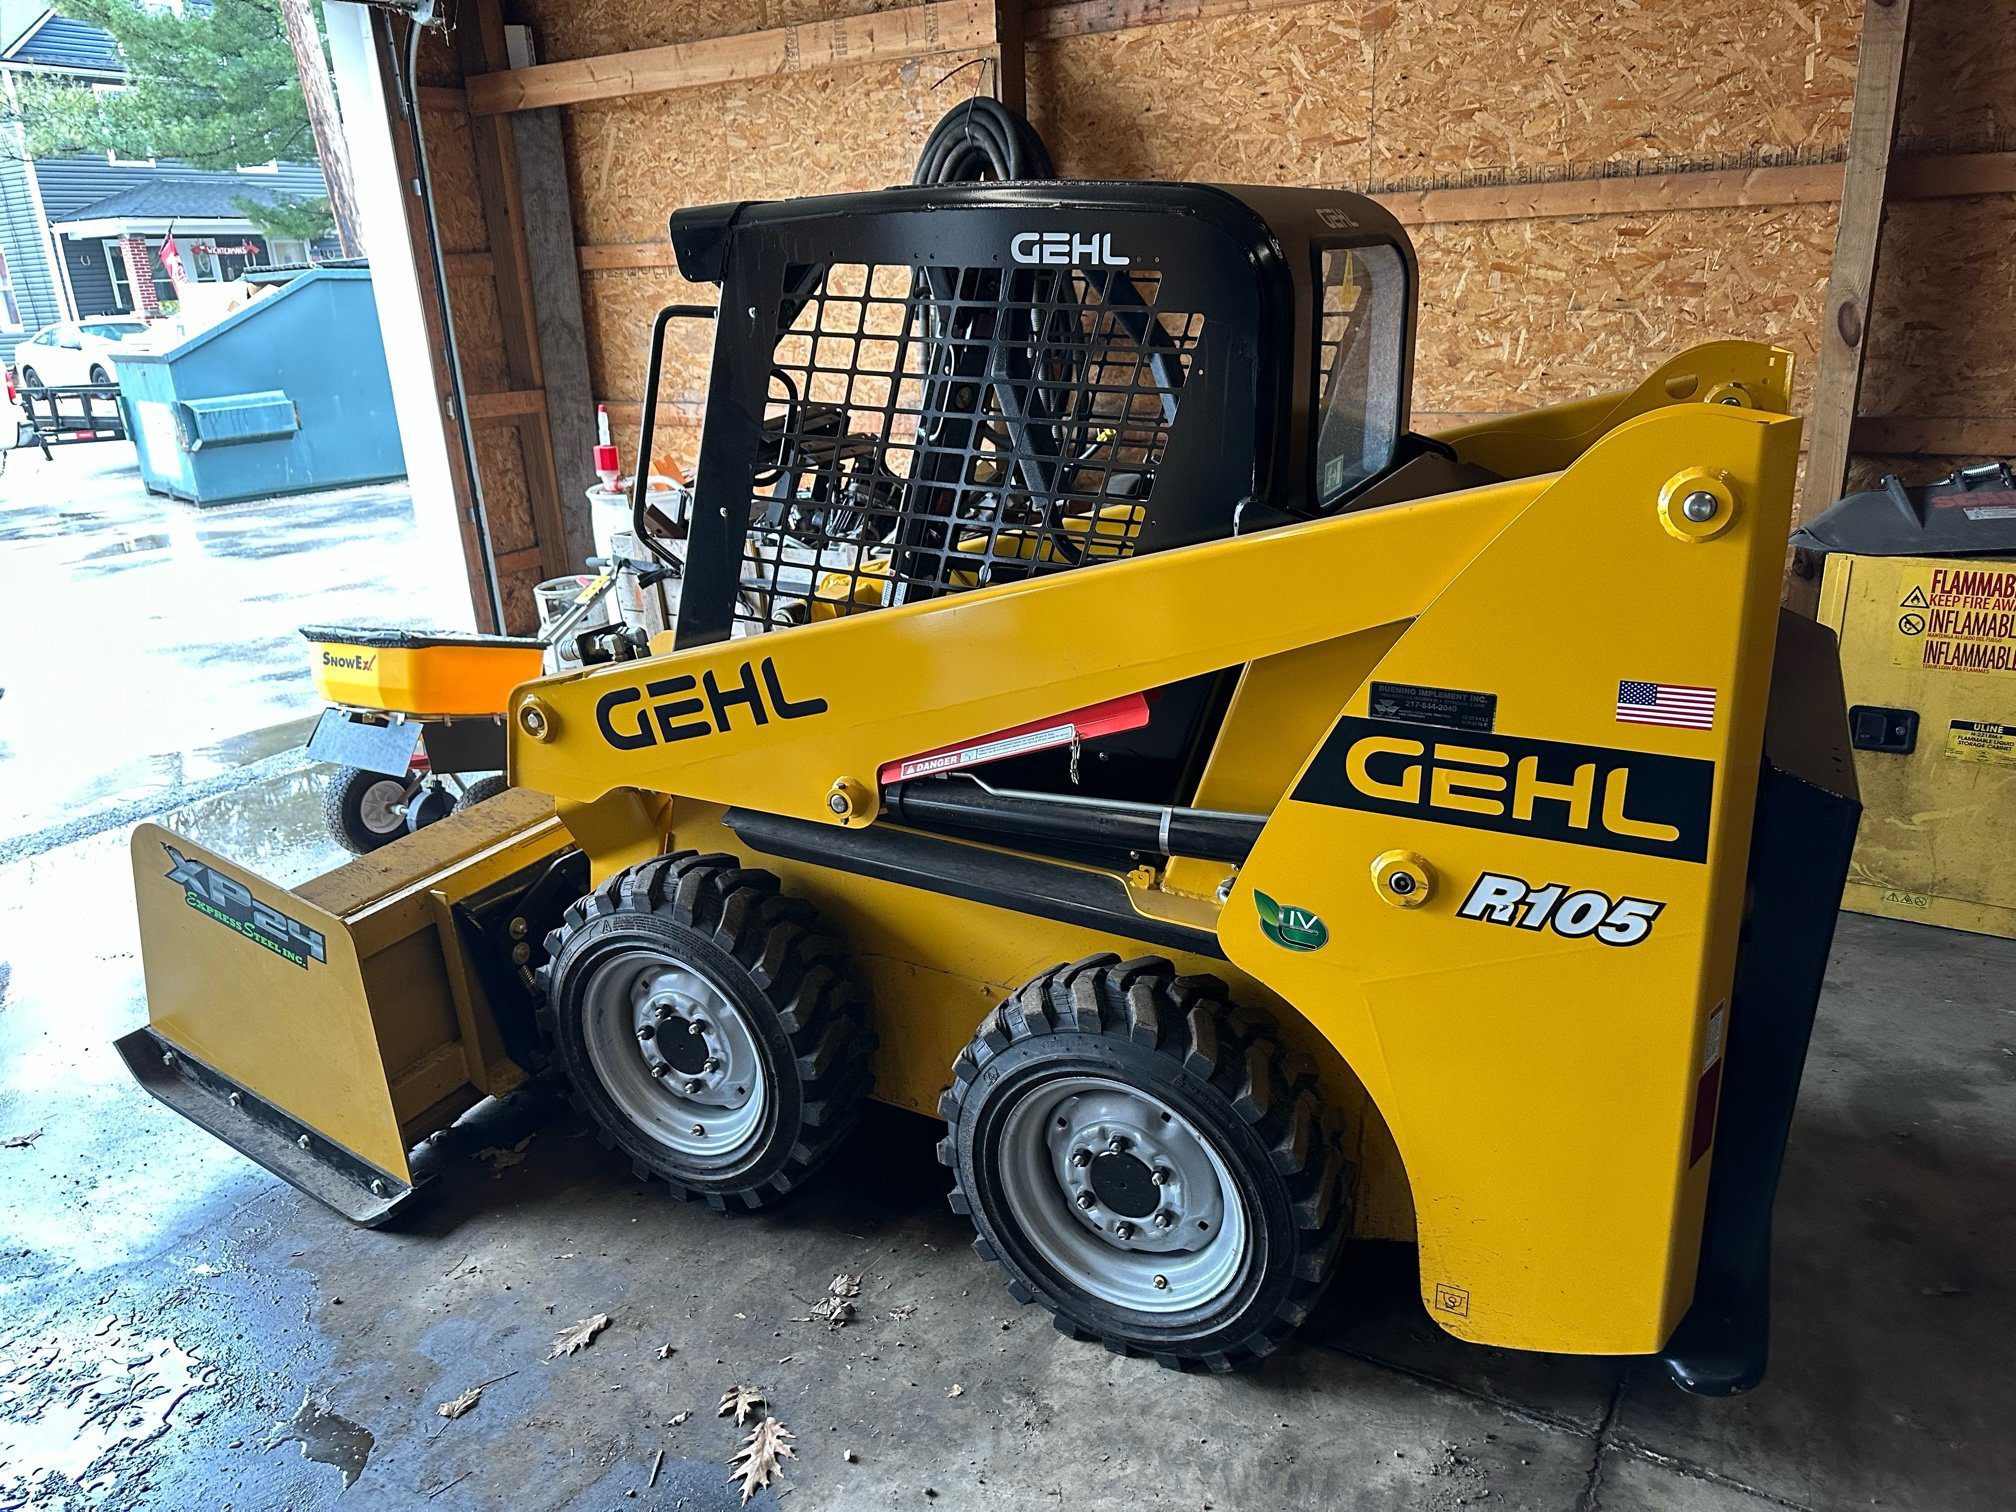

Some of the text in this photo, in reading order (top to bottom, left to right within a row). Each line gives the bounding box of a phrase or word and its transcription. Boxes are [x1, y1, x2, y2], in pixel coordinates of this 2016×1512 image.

[1315, 208, 1359, 229] GEHL
[1010, 231, 1131, 266] GEHL
[1931, 569, 2016, 598] FLAMMAB
[1929, 594, 1960, 607] KEEP
[1962, 596, 1991, 609] FIRE
[596, 656, 829, 750] GEHL
[1379, 685, 1417, 696] BUENING
[1418, 689, 1468, 701] IMPLEMENT
[1469, 694, 1488, 704] INC.
[1973, 723, 2004, 734] ULINE
[1957, 735, 1992, 744] FLAMMABLE
[1957, 740, 2012, 752] STORAGE CABINET
[916, 755, 958, 772] DANGER
[1345, 736, 1680, 842] GEHL
[1456, 871, 1667, 947] R105
[186, 892, 243, 931] EXPRESS
[242, 922, 282, 954] STEEL
